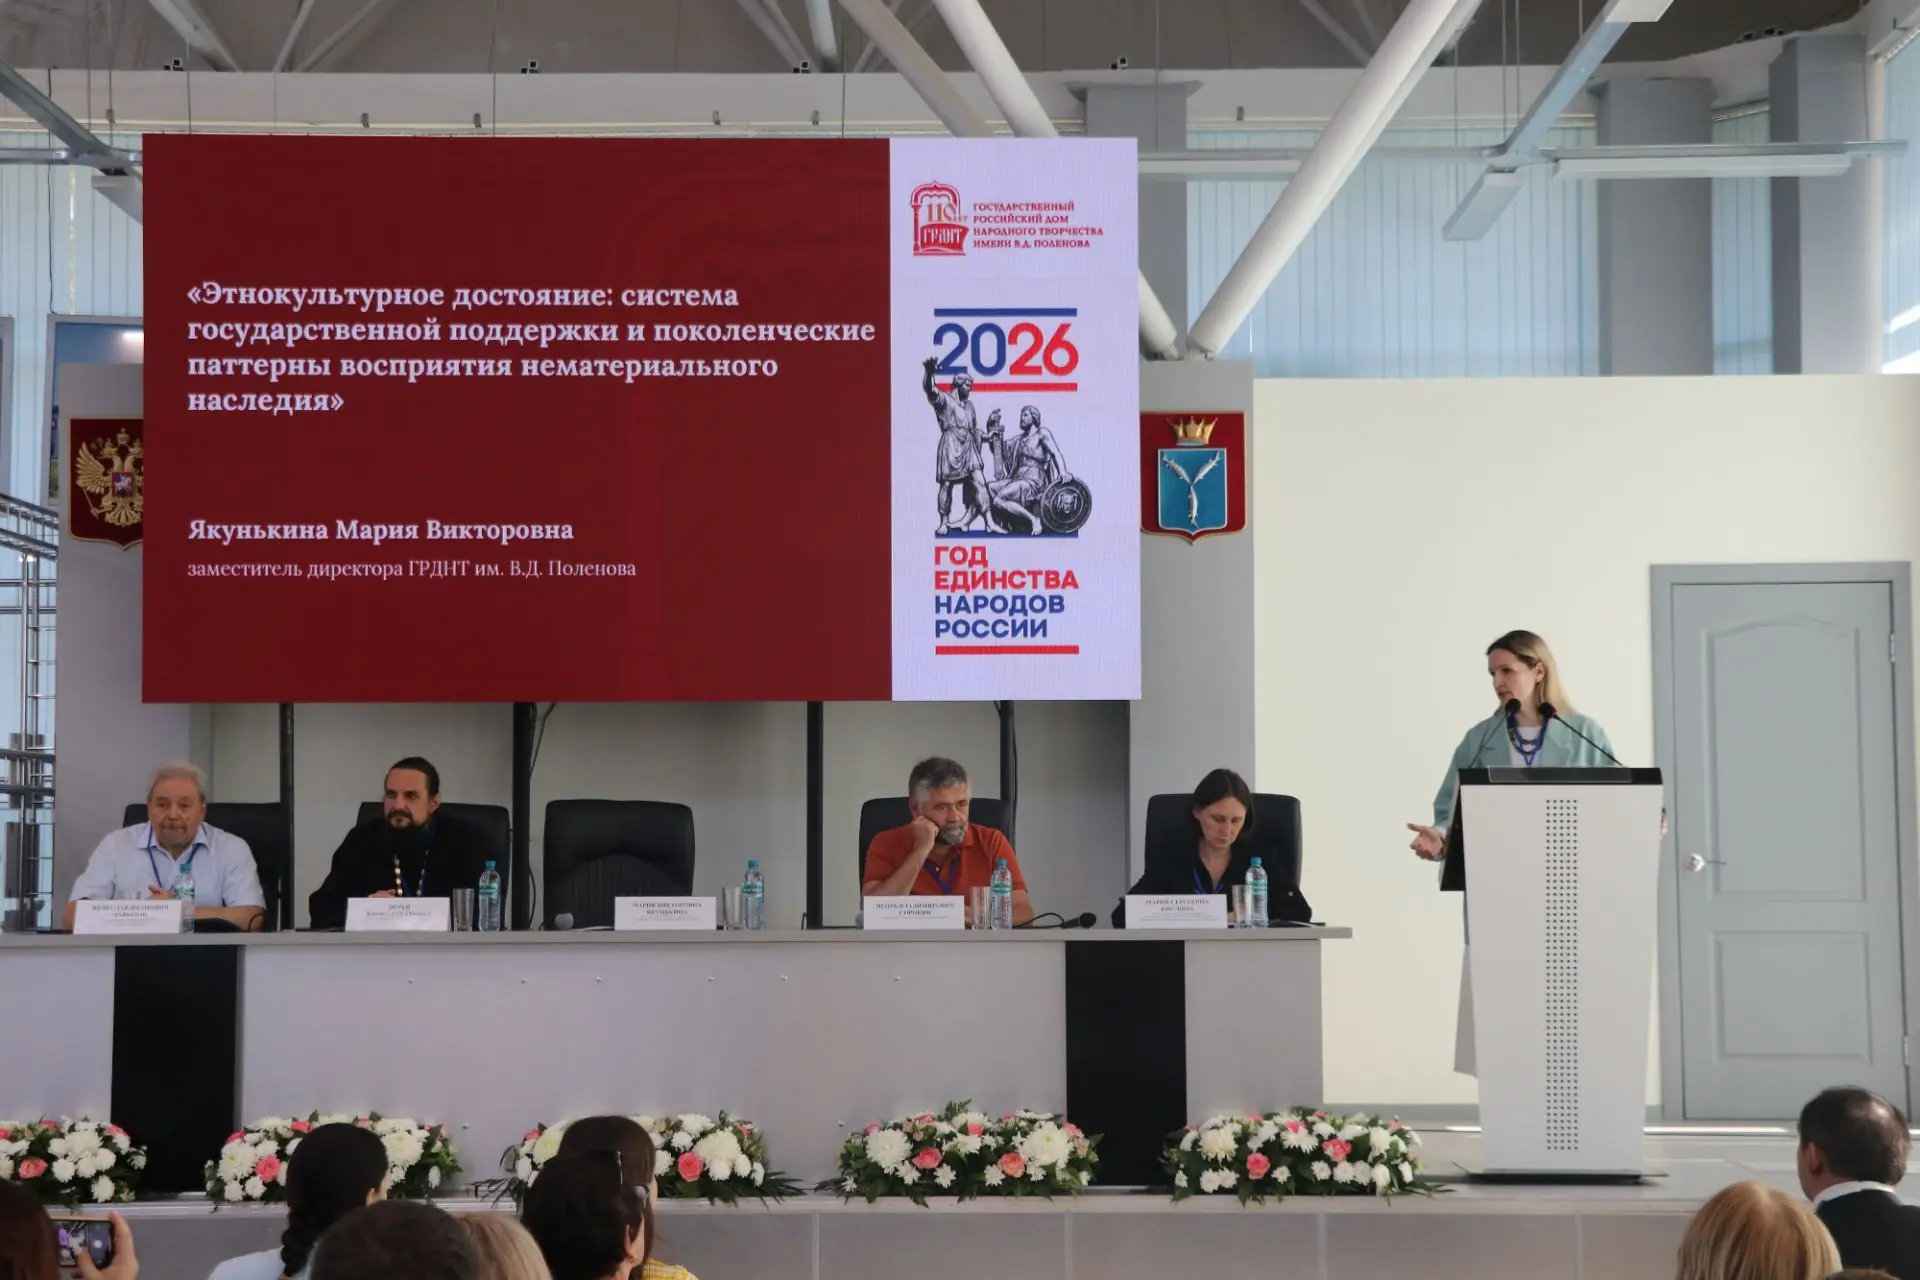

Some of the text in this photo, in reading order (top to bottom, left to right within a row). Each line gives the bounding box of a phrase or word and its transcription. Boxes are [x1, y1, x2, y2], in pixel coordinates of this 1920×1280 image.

[973, 201, 1075, 212] ГОСУДАРСТВЕННЫЙ
[973, 213, 1069, 225] РОССИЙСКИЙ ДОМ
[973, 227, 1104, 237] НАРОДНОГО ТВОРЧЕСТВА
[973, 239, 1091, 249] ИМЕНИ В.Д. ПОЛЕНОВА
[187, 281, 740, 312] «Этнокультурное достояние: система
[187, 317, 877, 347] государственной поддержки и поколенческие
[933, 322, 1079, 377] 2026
[187, 358, 779, 383] паттерны восприятия нематериального
[187, 393, 345, 416] наследия»
[187, 519, 575, 546] Якунькина Мария Викторовна
[934, 545, 989, 569] ГОД
[187, 559, 637, 581] заместитель директора ГРДНТ им. В.Д. Поленова
[934, 570, 1080, 593] ЕДИНСТВА
[934, 595, 1065, 617] НАРОДОВ
[935, 618, 1048, 639] РОССИИ
